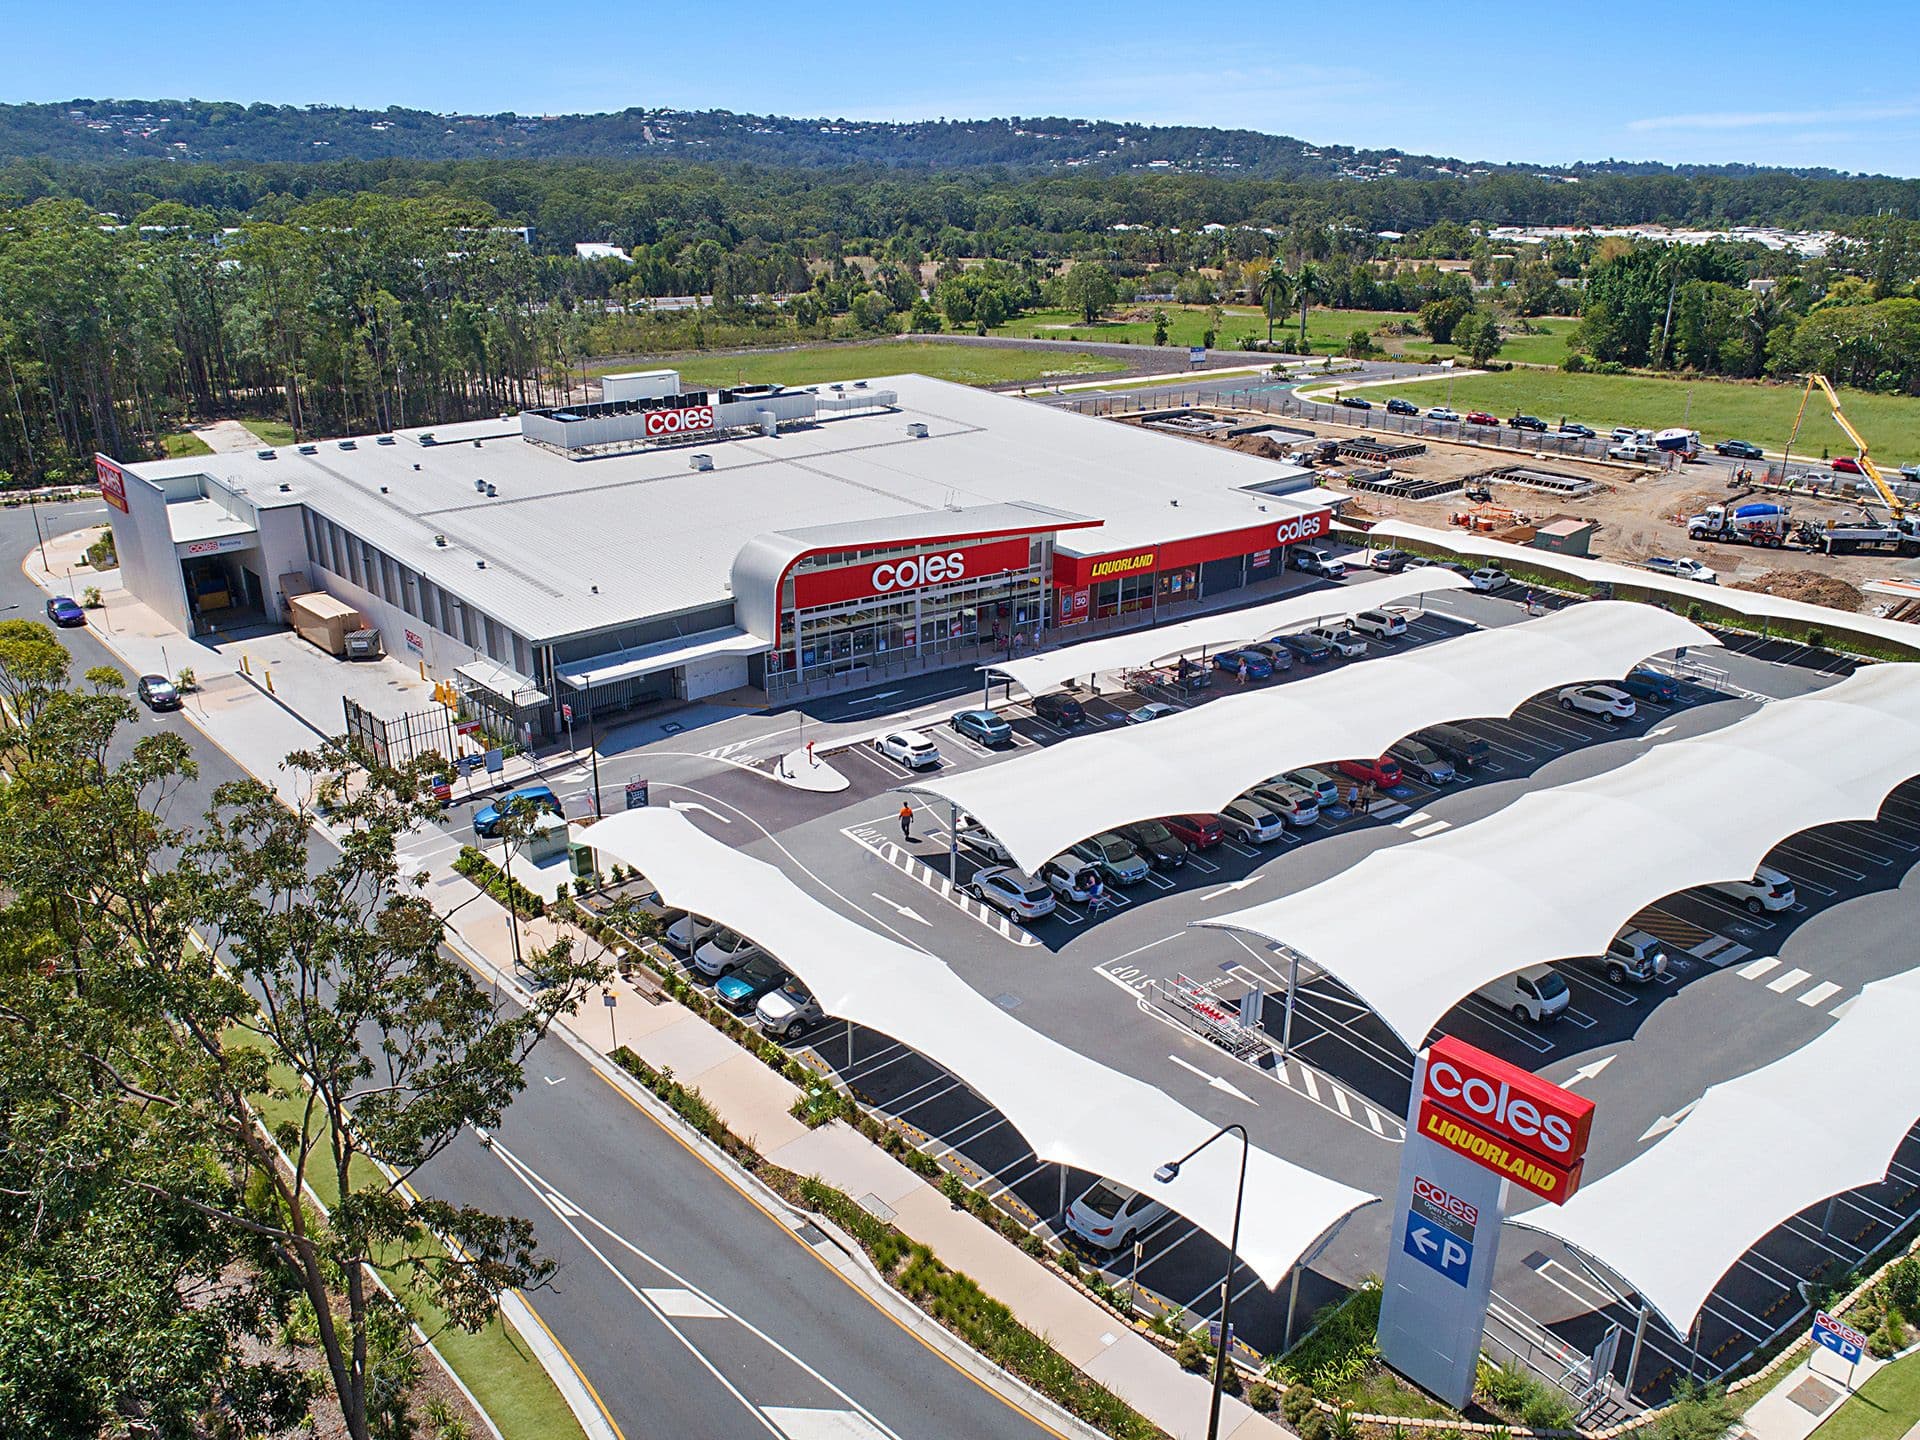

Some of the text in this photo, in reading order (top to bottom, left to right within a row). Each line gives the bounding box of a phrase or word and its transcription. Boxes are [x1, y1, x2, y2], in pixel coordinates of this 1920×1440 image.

[648, 409, 713, 433] coles
[97, 463, 122, 497] coles
[1277, 515, 1321, 543] coles
[189, 541, 218, 553] coles
[872, 552, 965, 592] coles
[1091, 553, 1154, 577] LIQUORLAND
[851, 827, 888, 844] STOP
[1110, 965, 1157, 990] STOP
[1429, 1062, 1572, 1153] coles
[1427, 1114, 1557, 1192] LIQUORLAND
[1416, 1180, 1476, 1223] coles
[1441, 1238, 1467, 1270] P
[1817, 1315, 1865, 1347] coles
[1839, 1341, 1857, 1356] P
